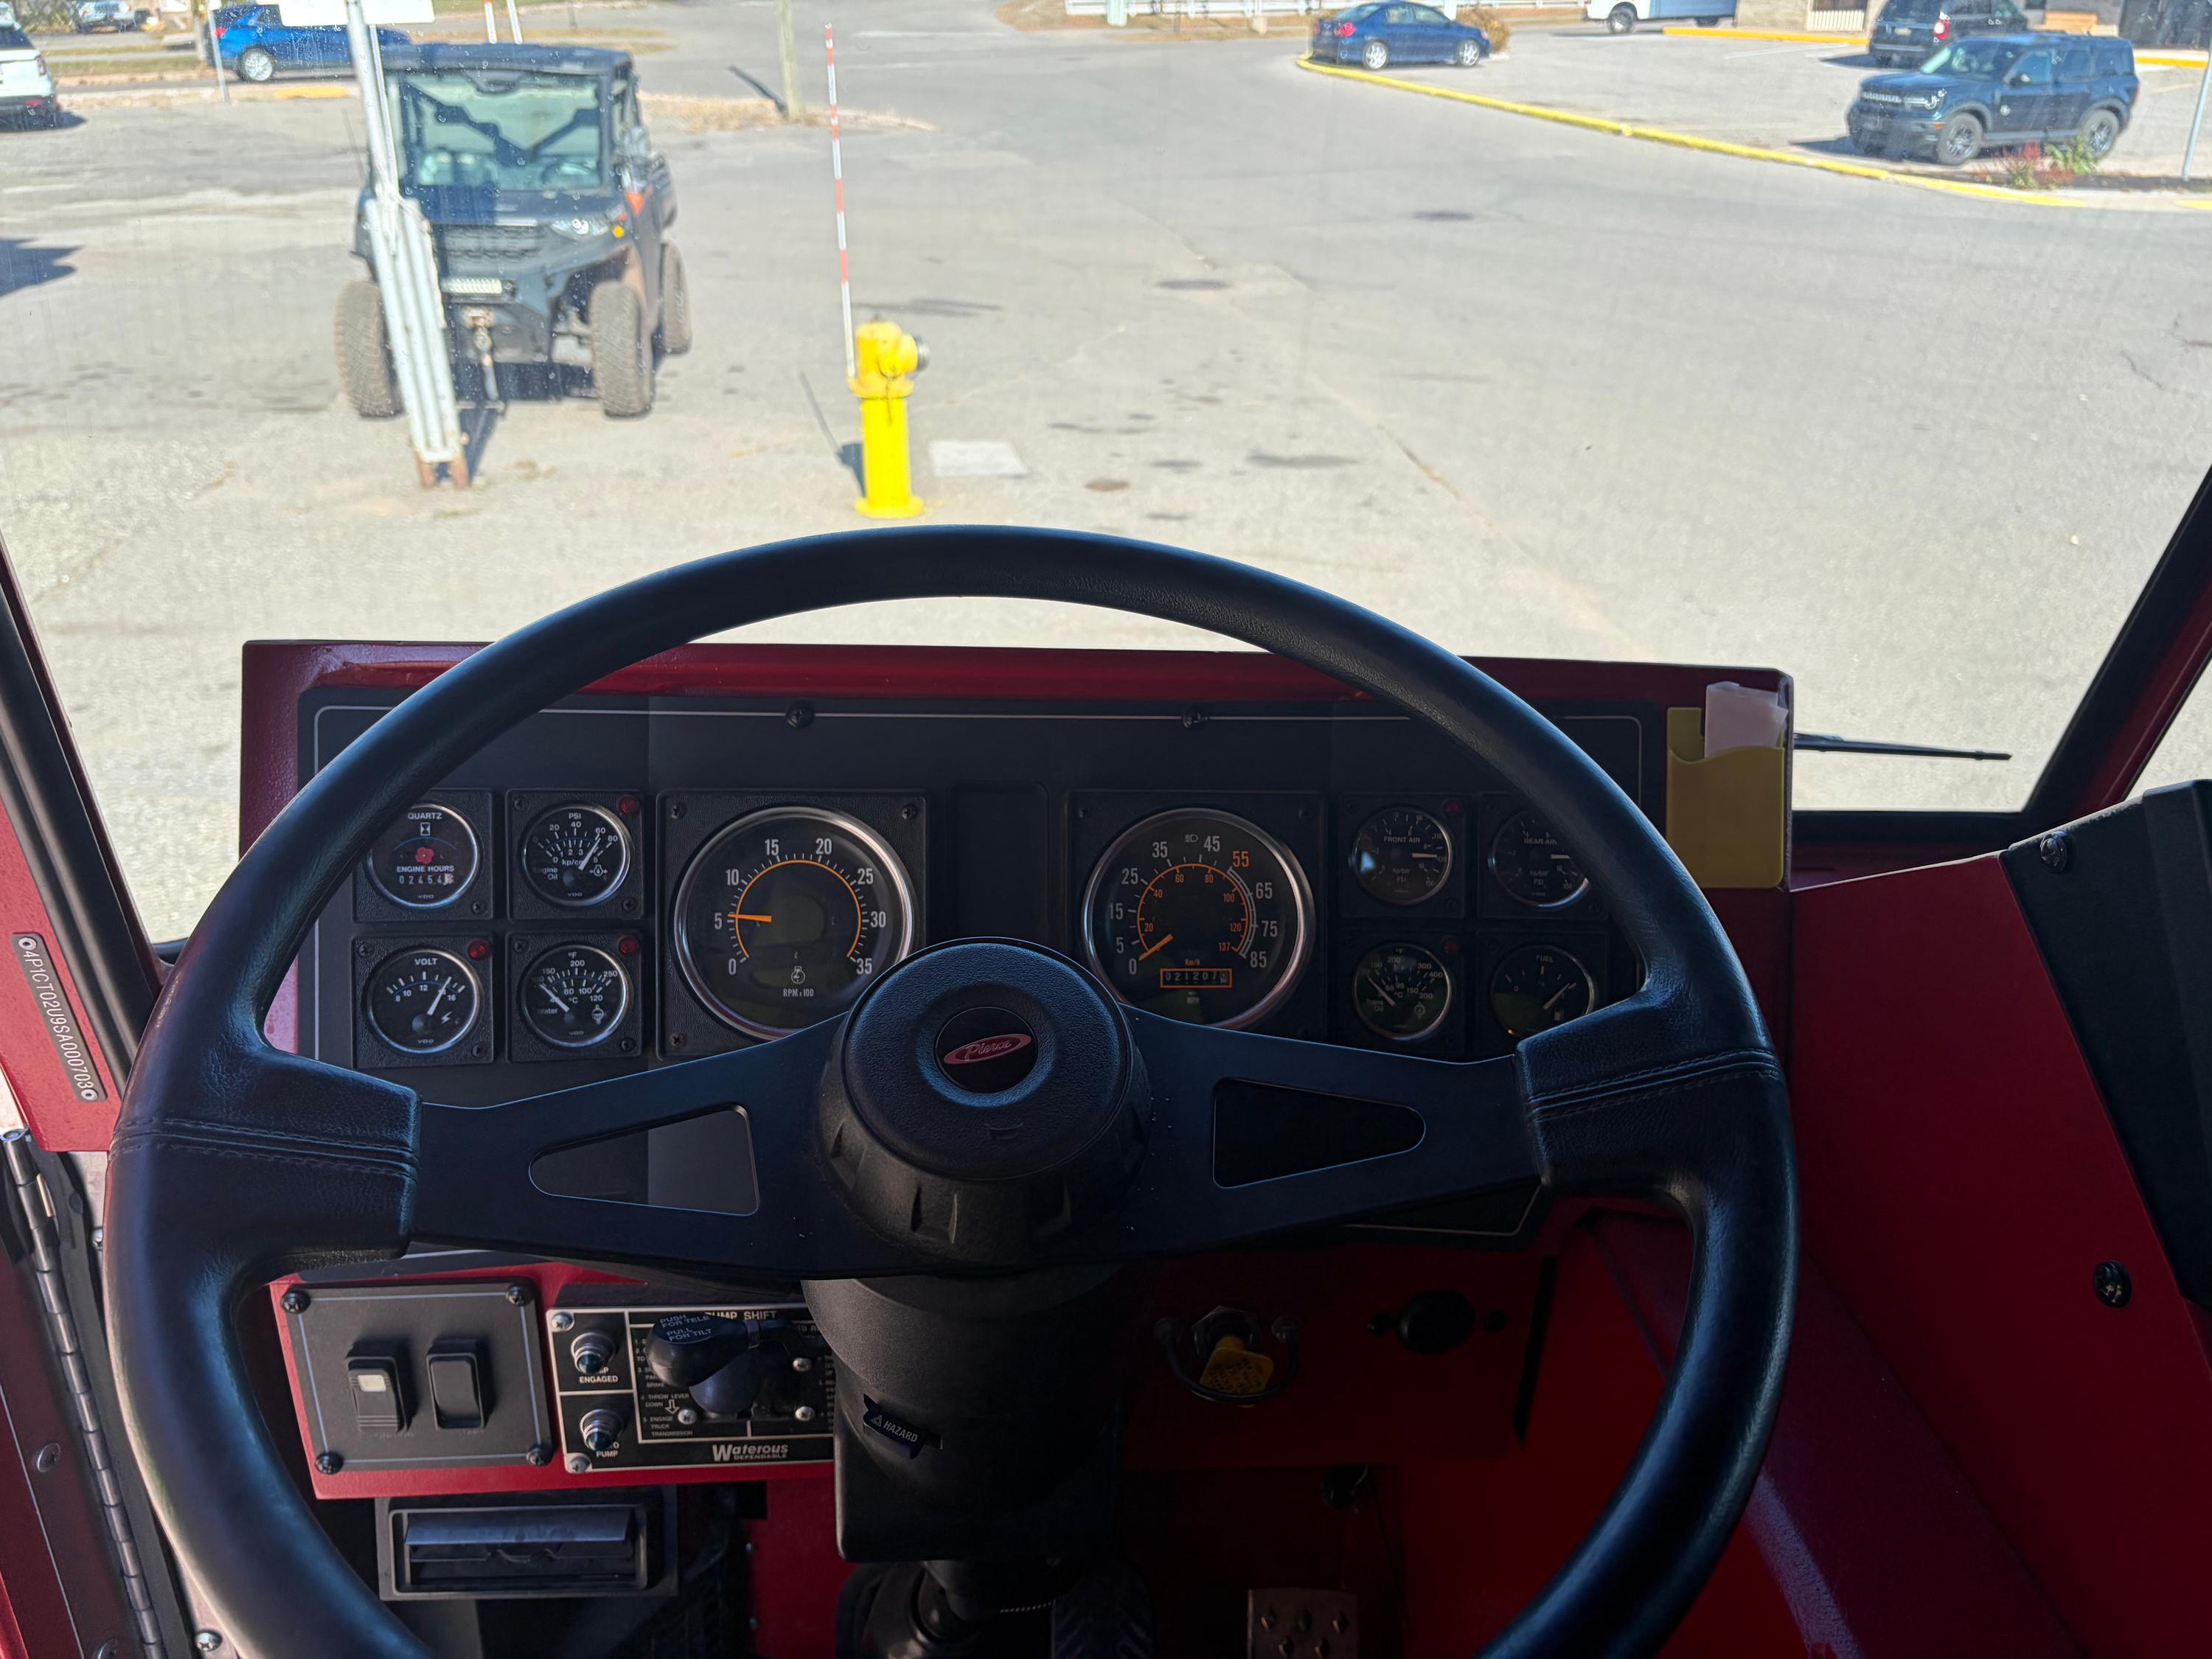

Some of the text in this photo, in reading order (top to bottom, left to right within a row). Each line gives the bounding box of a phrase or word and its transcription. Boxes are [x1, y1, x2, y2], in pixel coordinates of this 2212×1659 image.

[1204, 835, 1220, 852] 45
[1383, 835, 1407, 844] FRONT
[765, 838, 779, 855] 15
[815, 838, 832, 855] 20
[1152, 841, 1168, 858] 35
[1232, 850, 1250, 868] 55
[428, 864, 455, 872] HOURS
[726, 869, 739, 886] 10
[858, 868, 874, 885] 25
[1121, 868, 1138, 885] 25
[1175, 874, 1184, 884] 60
[1204, 874, 1214, 884] 80
[1533, 877, 1544, 886] PSI
[1153, 888, 1163, 899] 40
[1255, 882, 1273, 900] 65
[1222, 893, 1235, 903] 100
[1108, 902, 1123, 919] 15
[714, 912, 723, 929] 5
[870, 911, 886, 928] 30
[1144, 922, 1153, 933] 20
[1229, 922, 1242, 933] 120
[1262, 921, 1278, 938] 75
[1116, 936, 1124, 953] 5
[1218, 942, 1231, 952] 137
[414, 958, 438, 966] VOLT
[570, 959, 585, 967] 200
[1250, 951, 1267, 969] 85
[1536, 954, 1554, 963] FUEL
[728, 958, 737, 975] 0
[856, 958, 872, 975] 35
[1128, 958, 1137, 975] 0
[603, 970, 618, 978] 250
[590, 994, 603, 1002] 120
[783, 988, 799, 997] RPM
[803, 988, 814, 997] 100
[964, 1039, 1013, 1061] Pierce
[661, 1315, 686, 1324] PUSH
[684, 1315, 709, 1324] TELE
[743, 1310, 778, 1321] SHIFT
[667, 1328, 692, 1336] PULL
[669, 1328, 712, 1341] FOR TILT
[579, 1375, 619, 1384] ENGAGED
[883, 1420, 919, 1443] HAZARD
[596, 1450, 619, 1458] PUMP
[712, 1444, 789, 1461] Waterous
